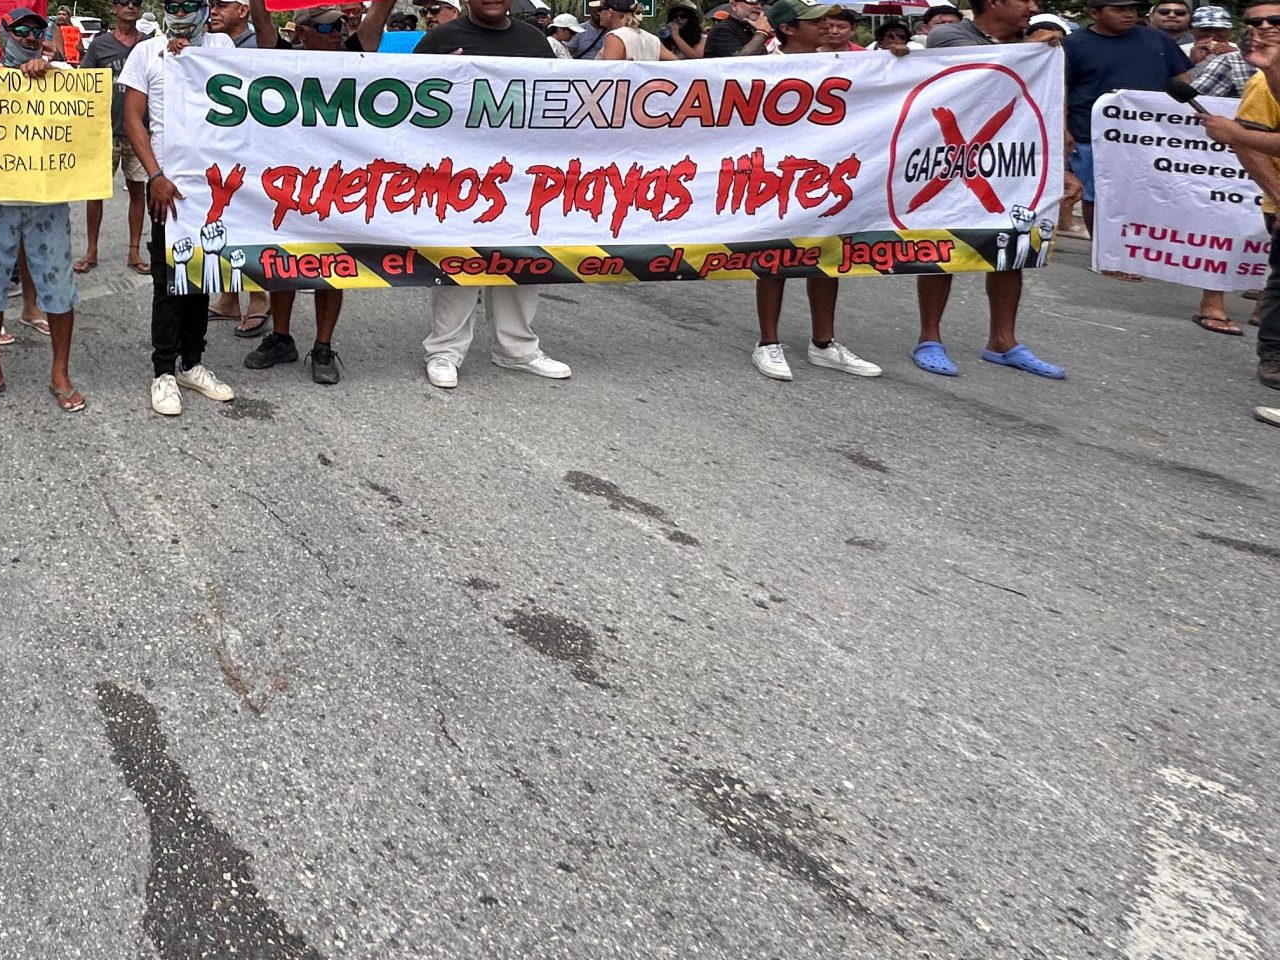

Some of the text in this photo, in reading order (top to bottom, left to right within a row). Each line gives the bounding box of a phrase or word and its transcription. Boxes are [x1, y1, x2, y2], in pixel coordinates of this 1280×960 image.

[53, 71, 104, 93] DONDE
[26, 100, 45, 116] NO
[50, 100, 95, 117] DONDE
[205, 73, 852, 129] SOMOS MEXICANOS
[14, 125, 73, 143] MANDE
[904, 142, 1036, 184] GAFSACOMM
[261, 156, 513, 231] queremos
[524, 154, 698, 238] playas
[716, 147, 861, 220] libres
[1210, 190, 1243, 205] no
[1121, 222, 1233, 252] ¡TULUM
[259, 237, 956, 280] fuera el cobro en el parque jaguar
[1124, 244, 1268, 276] TULUM SE
